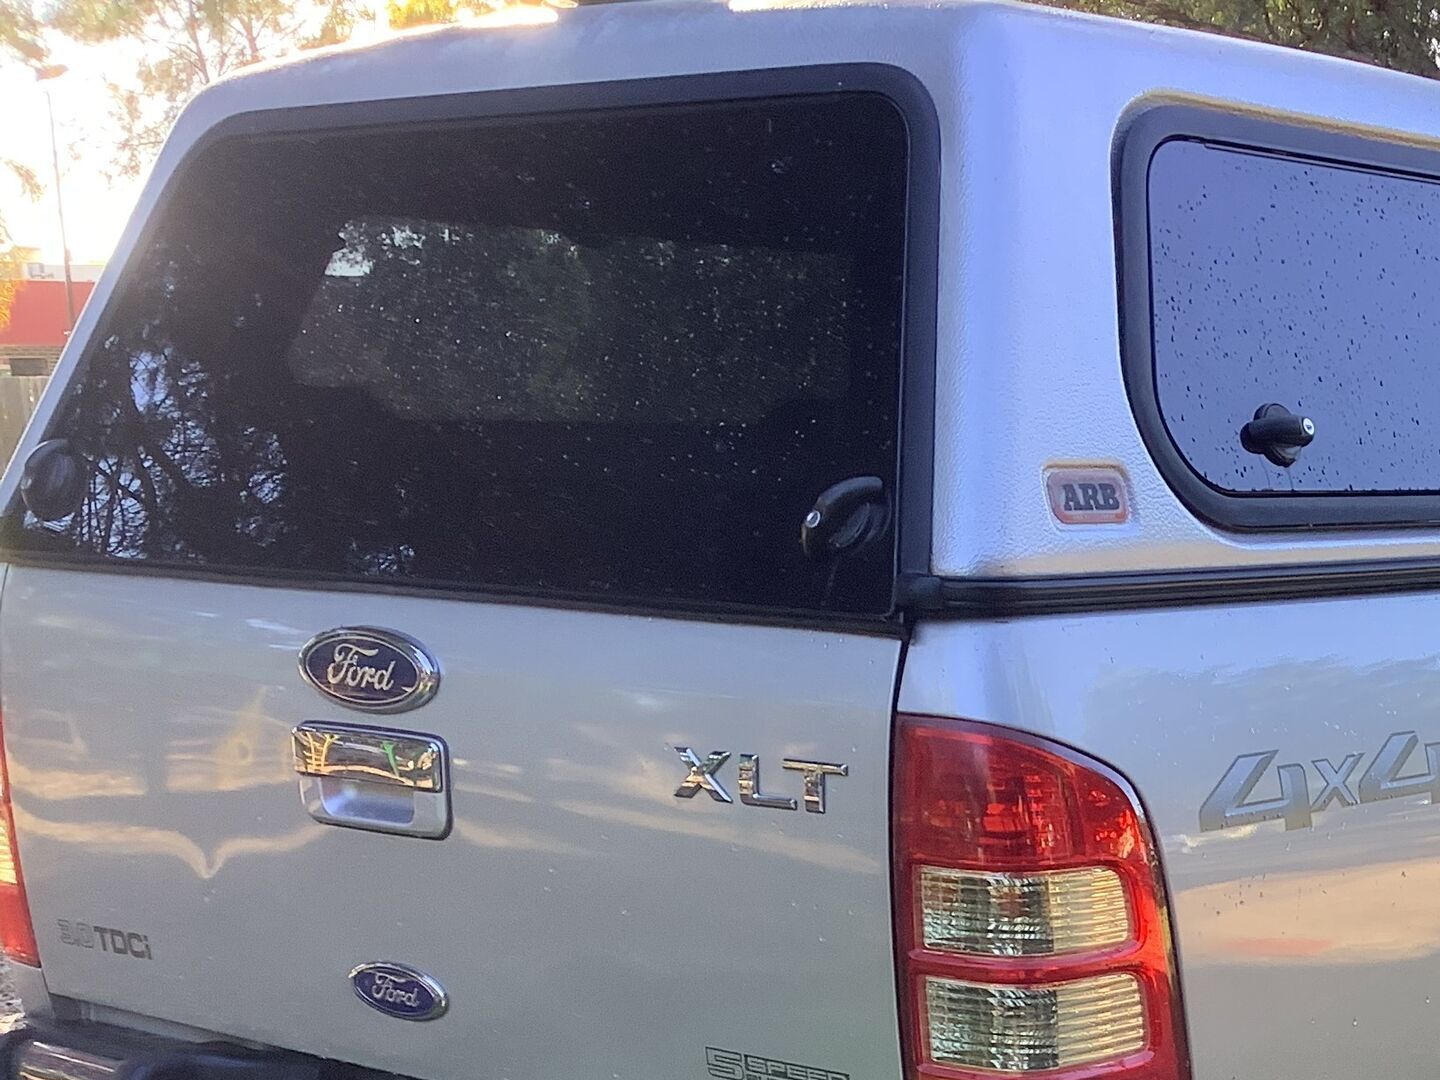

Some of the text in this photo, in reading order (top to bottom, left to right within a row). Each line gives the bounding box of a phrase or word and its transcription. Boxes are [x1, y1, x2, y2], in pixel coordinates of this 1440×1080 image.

[1063, 482, 1120, 511] ARB
[327, 643, 397, 691] Ford
[674, 746, 848, 814] XLT
[371, 972, 420, 1008] Ford
